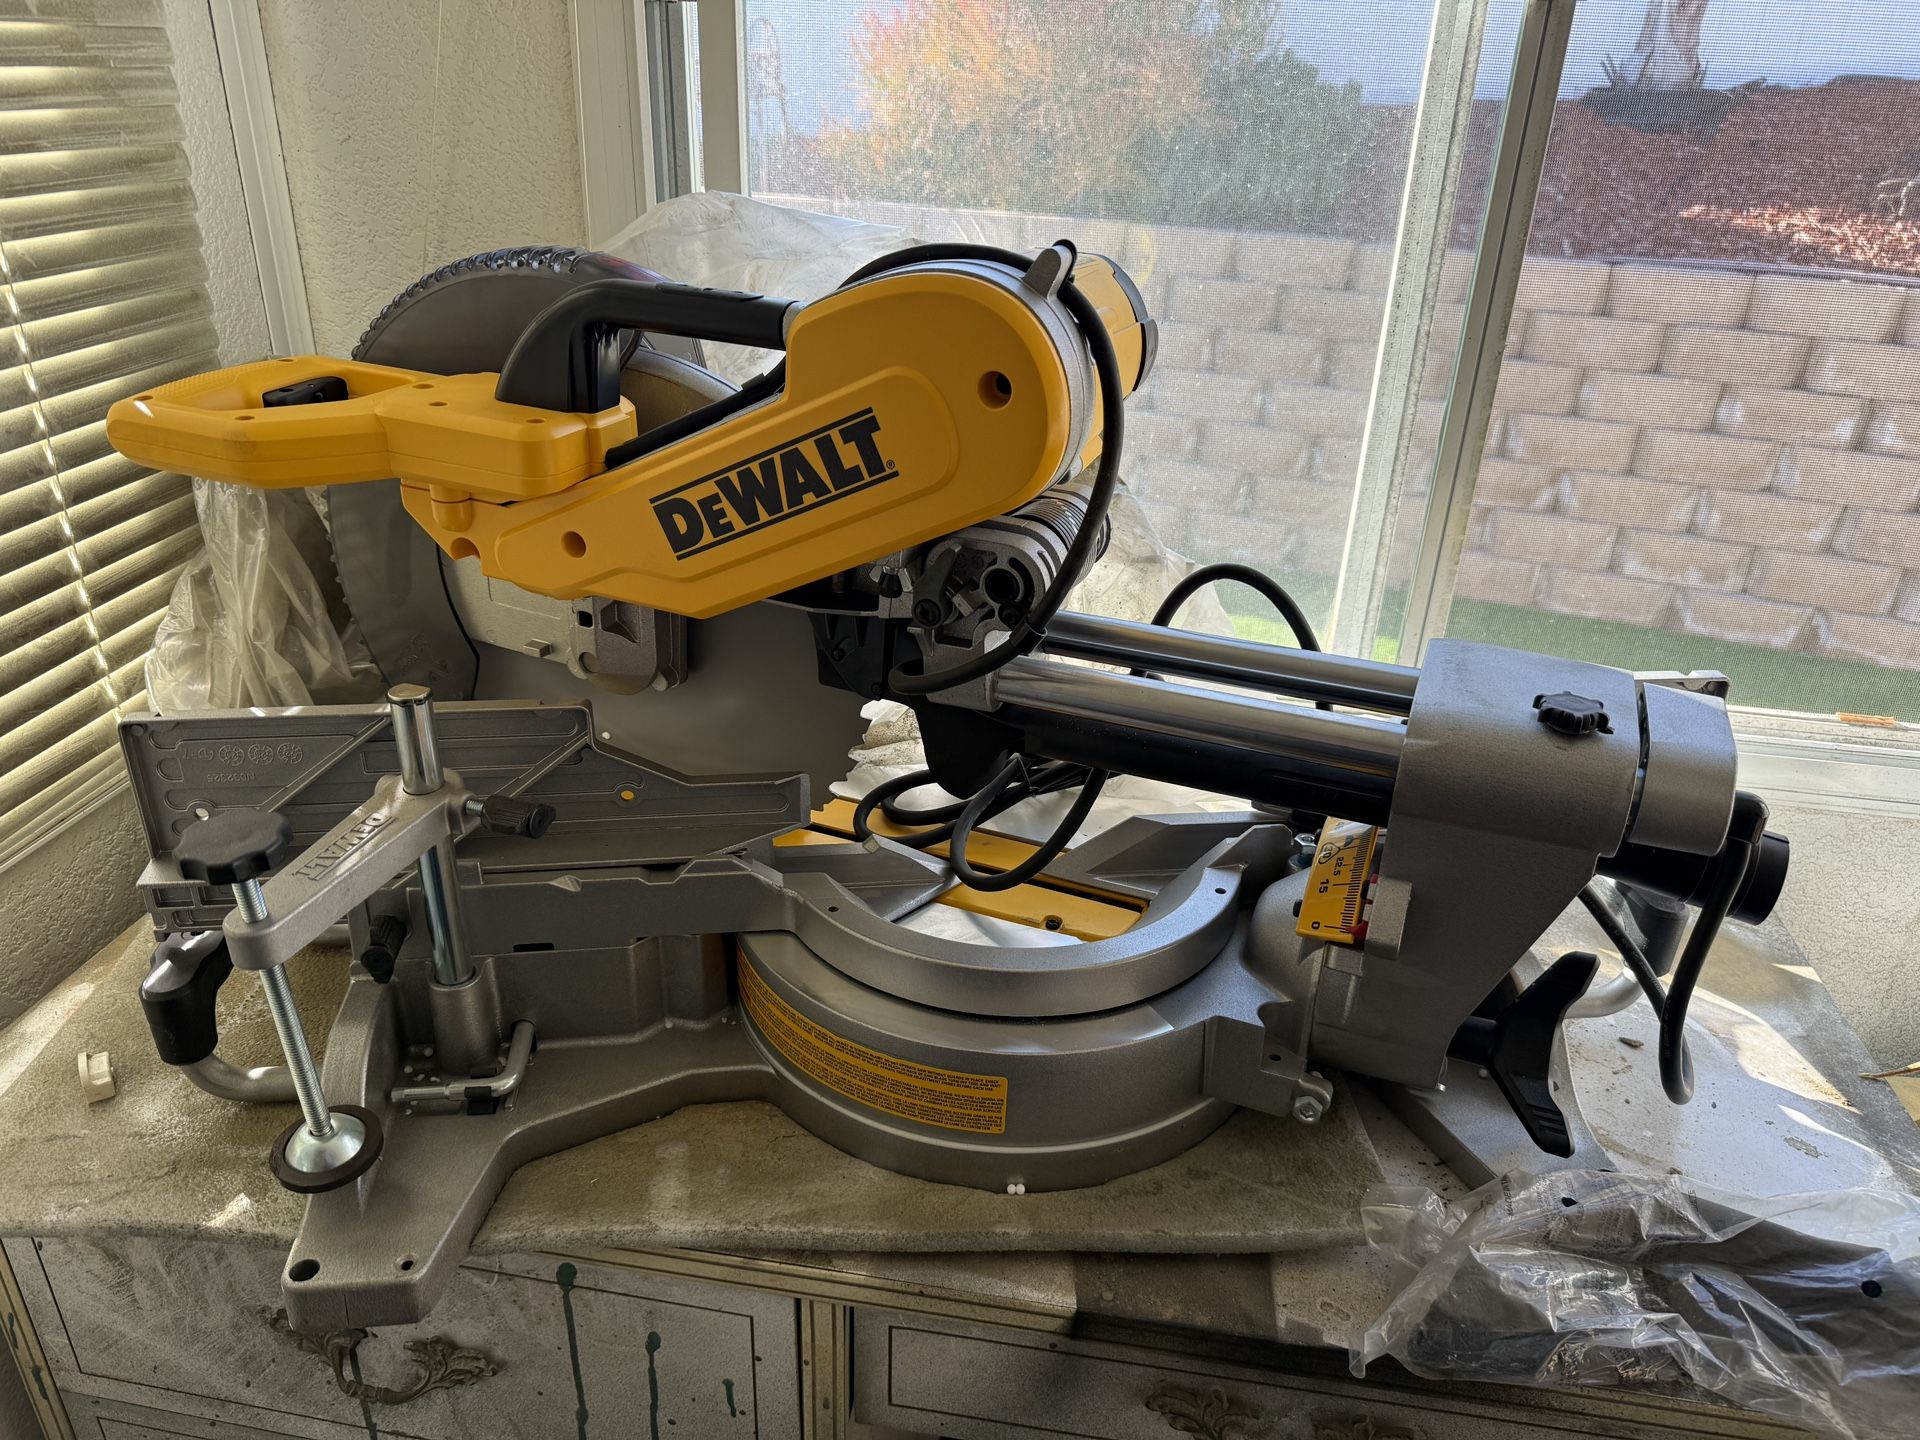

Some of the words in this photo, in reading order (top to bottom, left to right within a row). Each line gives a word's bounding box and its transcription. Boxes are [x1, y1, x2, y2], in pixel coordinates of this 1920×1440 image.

[1322, 846, 1333, 859] 30
[1333, 857, 1344, 877] 22.5
[1318, 878, 1330, 894] 15
[1311, 921, 1320, 930] 0
